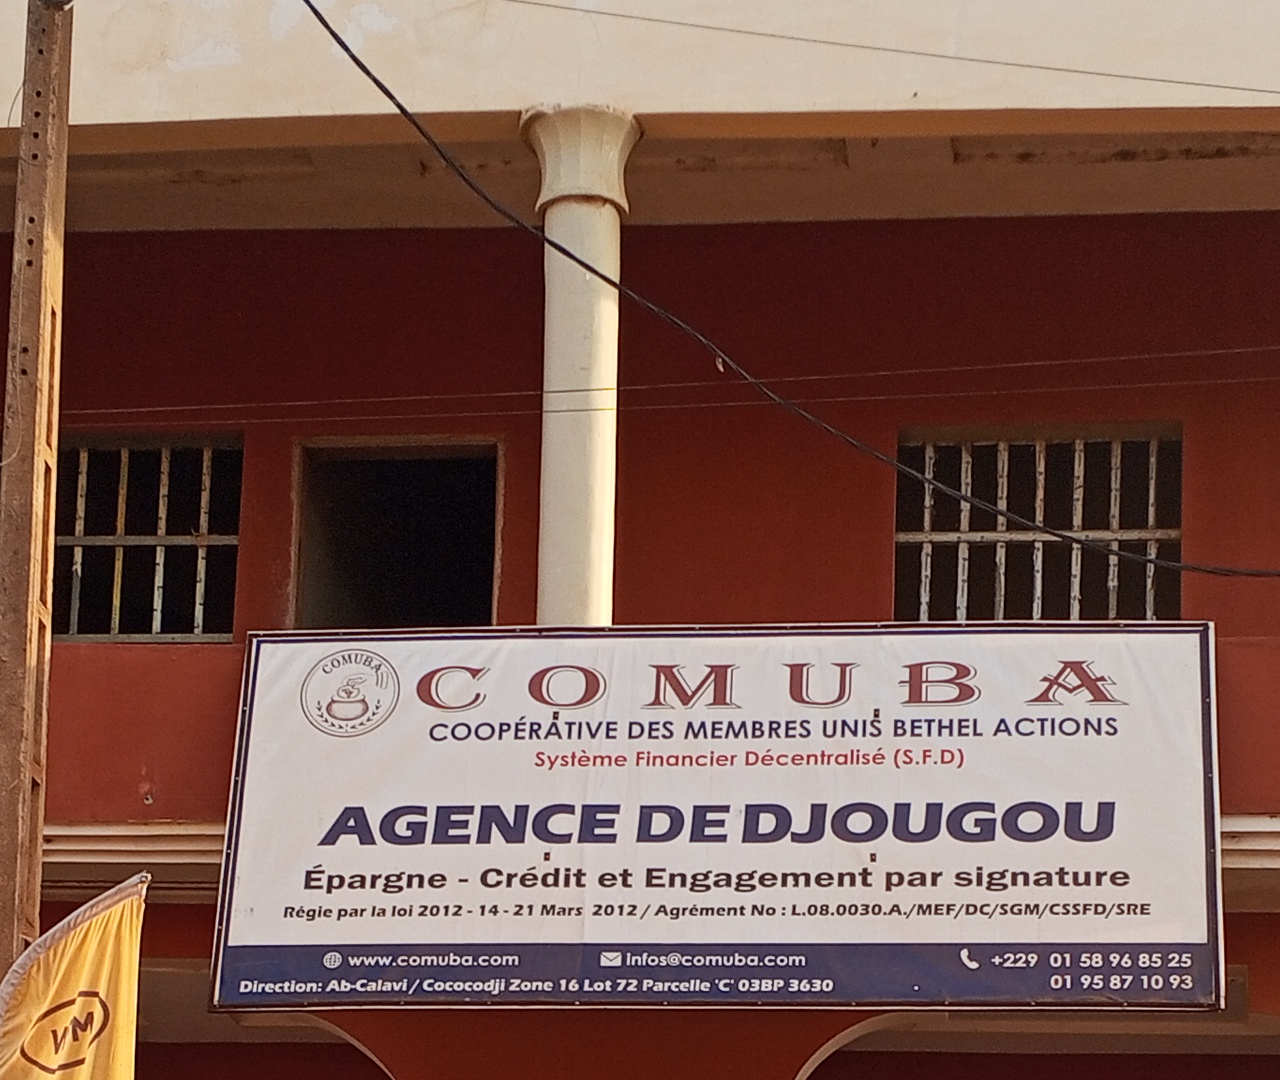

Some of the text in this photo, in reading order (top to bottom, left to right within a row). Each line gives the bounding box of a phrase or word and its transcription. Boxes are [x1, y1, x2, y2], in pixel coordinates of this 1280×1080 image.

[322, 653, 382, 674] COMUBA
[416, 661, 1128, 712] COMUBA
[429, 716, 1118, 741] COOPÉRATIVE DES MEMBRES UNIS BETHEL ACTIONS
[534, 748, 965, 770] Système Financier Décentralisé (S.F.D)
[317, 801, 1116, 846] AGENCE DE DJOUGOU
[303, 864, 447, 894] Épargne
[479, 866, 586, 889] Crédit
[597, 869, 633, 889] et
[645, 866, 873, 893] Engagement
[885, 869, 943, 892] par
[953, 866, 1131, 892] signature
[283, 905, 332, 922] Régie
[336, 908, 367, 921] par
[371, 904, 386, 918] la
[391, 904, 413, 917] loi
[418, 904, 463, 917] 2012
[479, 904, 499, 917] 14
[513, 904, 534, 917] 21
[540, 904, 583, 917] Mars
[592, 904, 637, 917] 2012
[654, 903, 746, 920] Agrément
[348, 953, 519, 967] www.comuba.com
[626, 952, 806, 967] infos@comuba.com
[990, 952, 1192, 968] +229 01 58 96 85 25
[239, 978, 323, 994] Direction:
[423, 978, 505, 995] Cococodji
[508, 978, 553, 993] Zone
[559, 978, 579, 992] 16
[583, 978, 612, 992] Lot
[616, 978, 638, 992] 72
[642, 978, 710, 992] Parcelle
[738, 978, 784, 992] 03BP
[788, 978, 834, 993] 3630
[1049, 975, 1193, 990] 01 95 87 10 93
